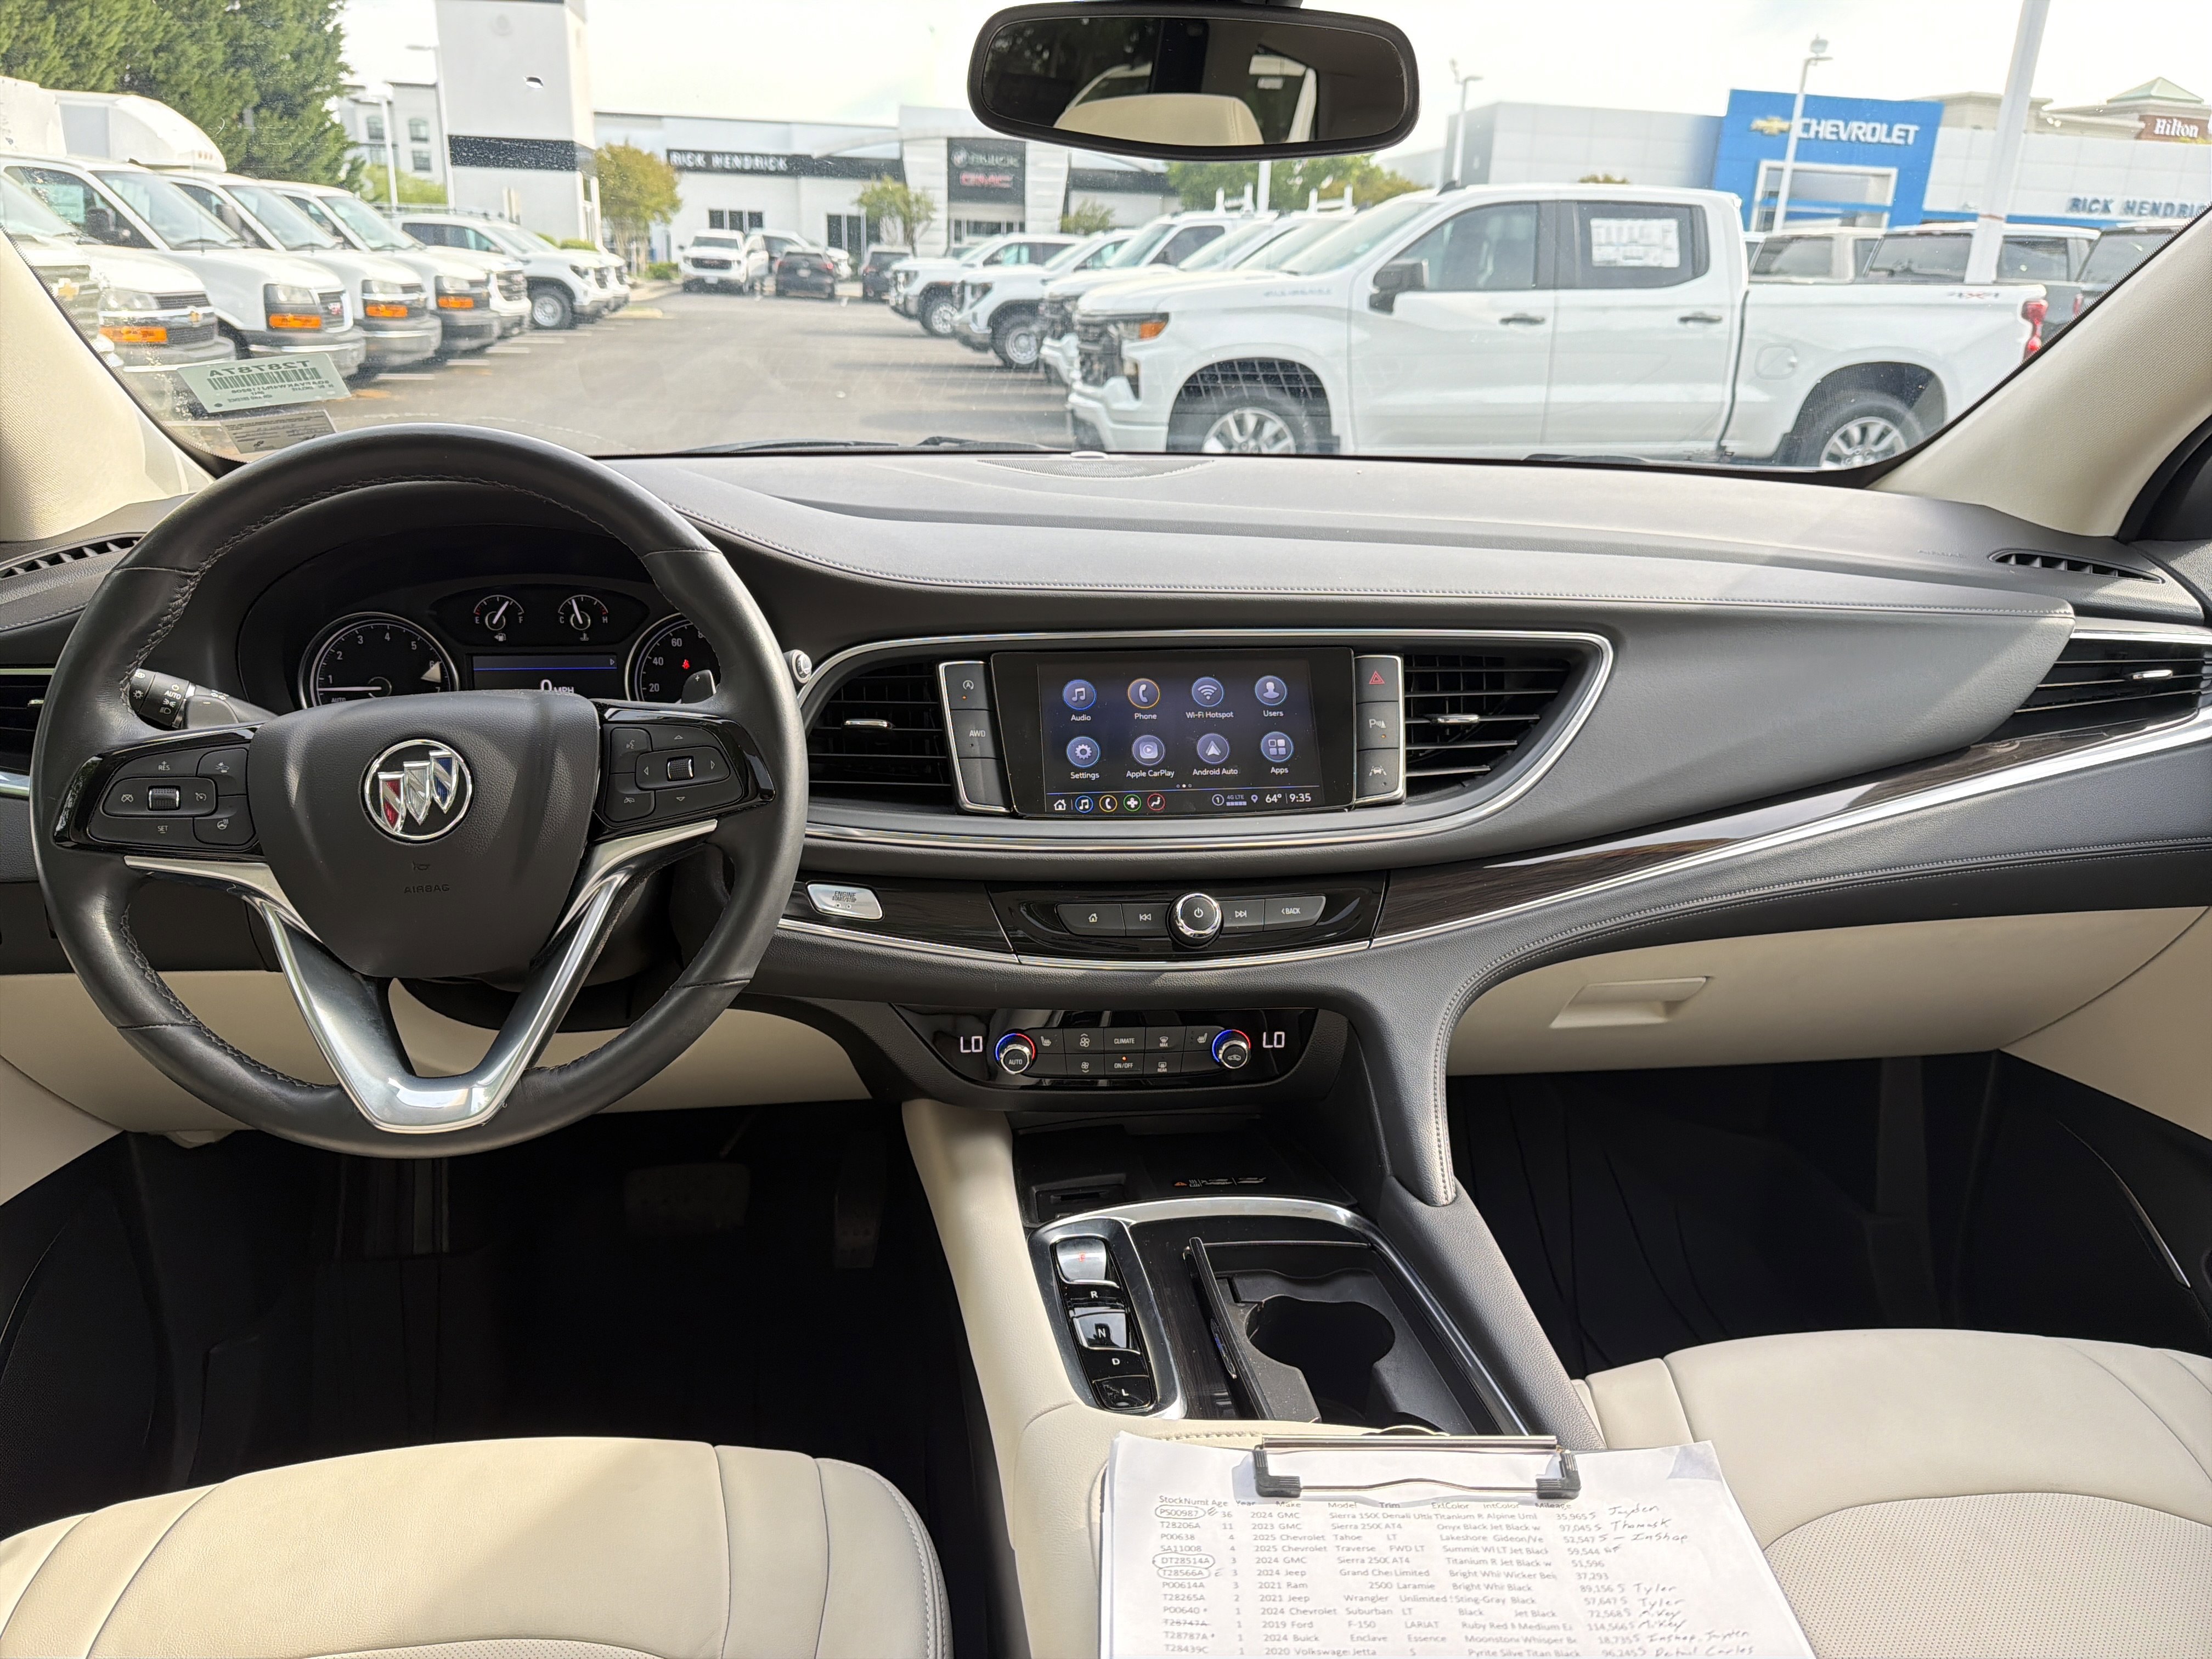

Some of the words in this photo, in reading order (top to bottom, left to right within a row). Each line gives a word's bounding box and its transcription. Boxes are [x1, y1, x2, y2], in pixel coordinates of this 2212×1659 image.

[1798, 118, 1919, 145] CHEVROLET
[2154, 118, 2198, 137] Hilton
[670, 151, 706, 167] RICK
[712, 154, 787, 171] HENDRICK
[2066, 198, 2114, 213] RICK
[358, 635, 364, 645] 3
[385, 633, 390, 641] 4
[672, 637, 682, 647] 60
[411, 641, 417, 651] 5
[336, 651, 343, 660] 2
[652, 657, 664, 666] 40
[649, 683, 659, 692] 20
[165, 690, 182, 701] AUTO
[1070, 771, 1100, 780] Settings
[1148, 770, 1175, 778] CarPlay
[1265, 793, 1282, 804] 64°
[1289, 793, 1311, 803] 9:35
[404, 884, 450, 894] AIRBAG
[834, 890, 856, 899] ENGINE
[960, 1035, 983, 1053] LO
[1262, 1031, 1285, 1048] LO
[1091, 1290, 1098, 1299] R
[1098, 1328, 1107, 1338] N
[1160, 1509, 1199, 1517] PS00987
[1559, 1524, 1592, 1532] 97,045
[1572, 1560, 1605, 1568] 51,596
[1449, 1570, 1477, 1579] Bright
[1576, 1572, 1609, 1581] 37,293
[1452, 1583, 1481, 1592] Bright
[1287, 1594, 1310, 1603] Jeep
[1343, 1594, 1390, 1603] Wrangler
[1455, 1595, 1506, 1605] Sting-Gray
[1510, 1596, 1536, 1604] Black
[1345, 1607, 1393, 1615] Suburban
[1531, 1610, 1556, 1618] Black
[1262, 1620, 1286, 1628] 2019
[1291, 1620, 1313, 1628] Ford
[1348, 1620, 1376, 1628] F-150
[1404, 1621, 1440, 1629] LARIAT
[1462, 1621, 1486, 1631] Ruby
[1163, 1631, 1209, 1640] T28787A
[1263, 1634, 1288, 1642] 2024
[1293, 1634, 1319, 1642] Buick
[1350, 1634, 1387, 1642] Enclave
[1407, 1634, 1447, 1643] Essence
[1265, 1647, 1290, 1655] 2020
